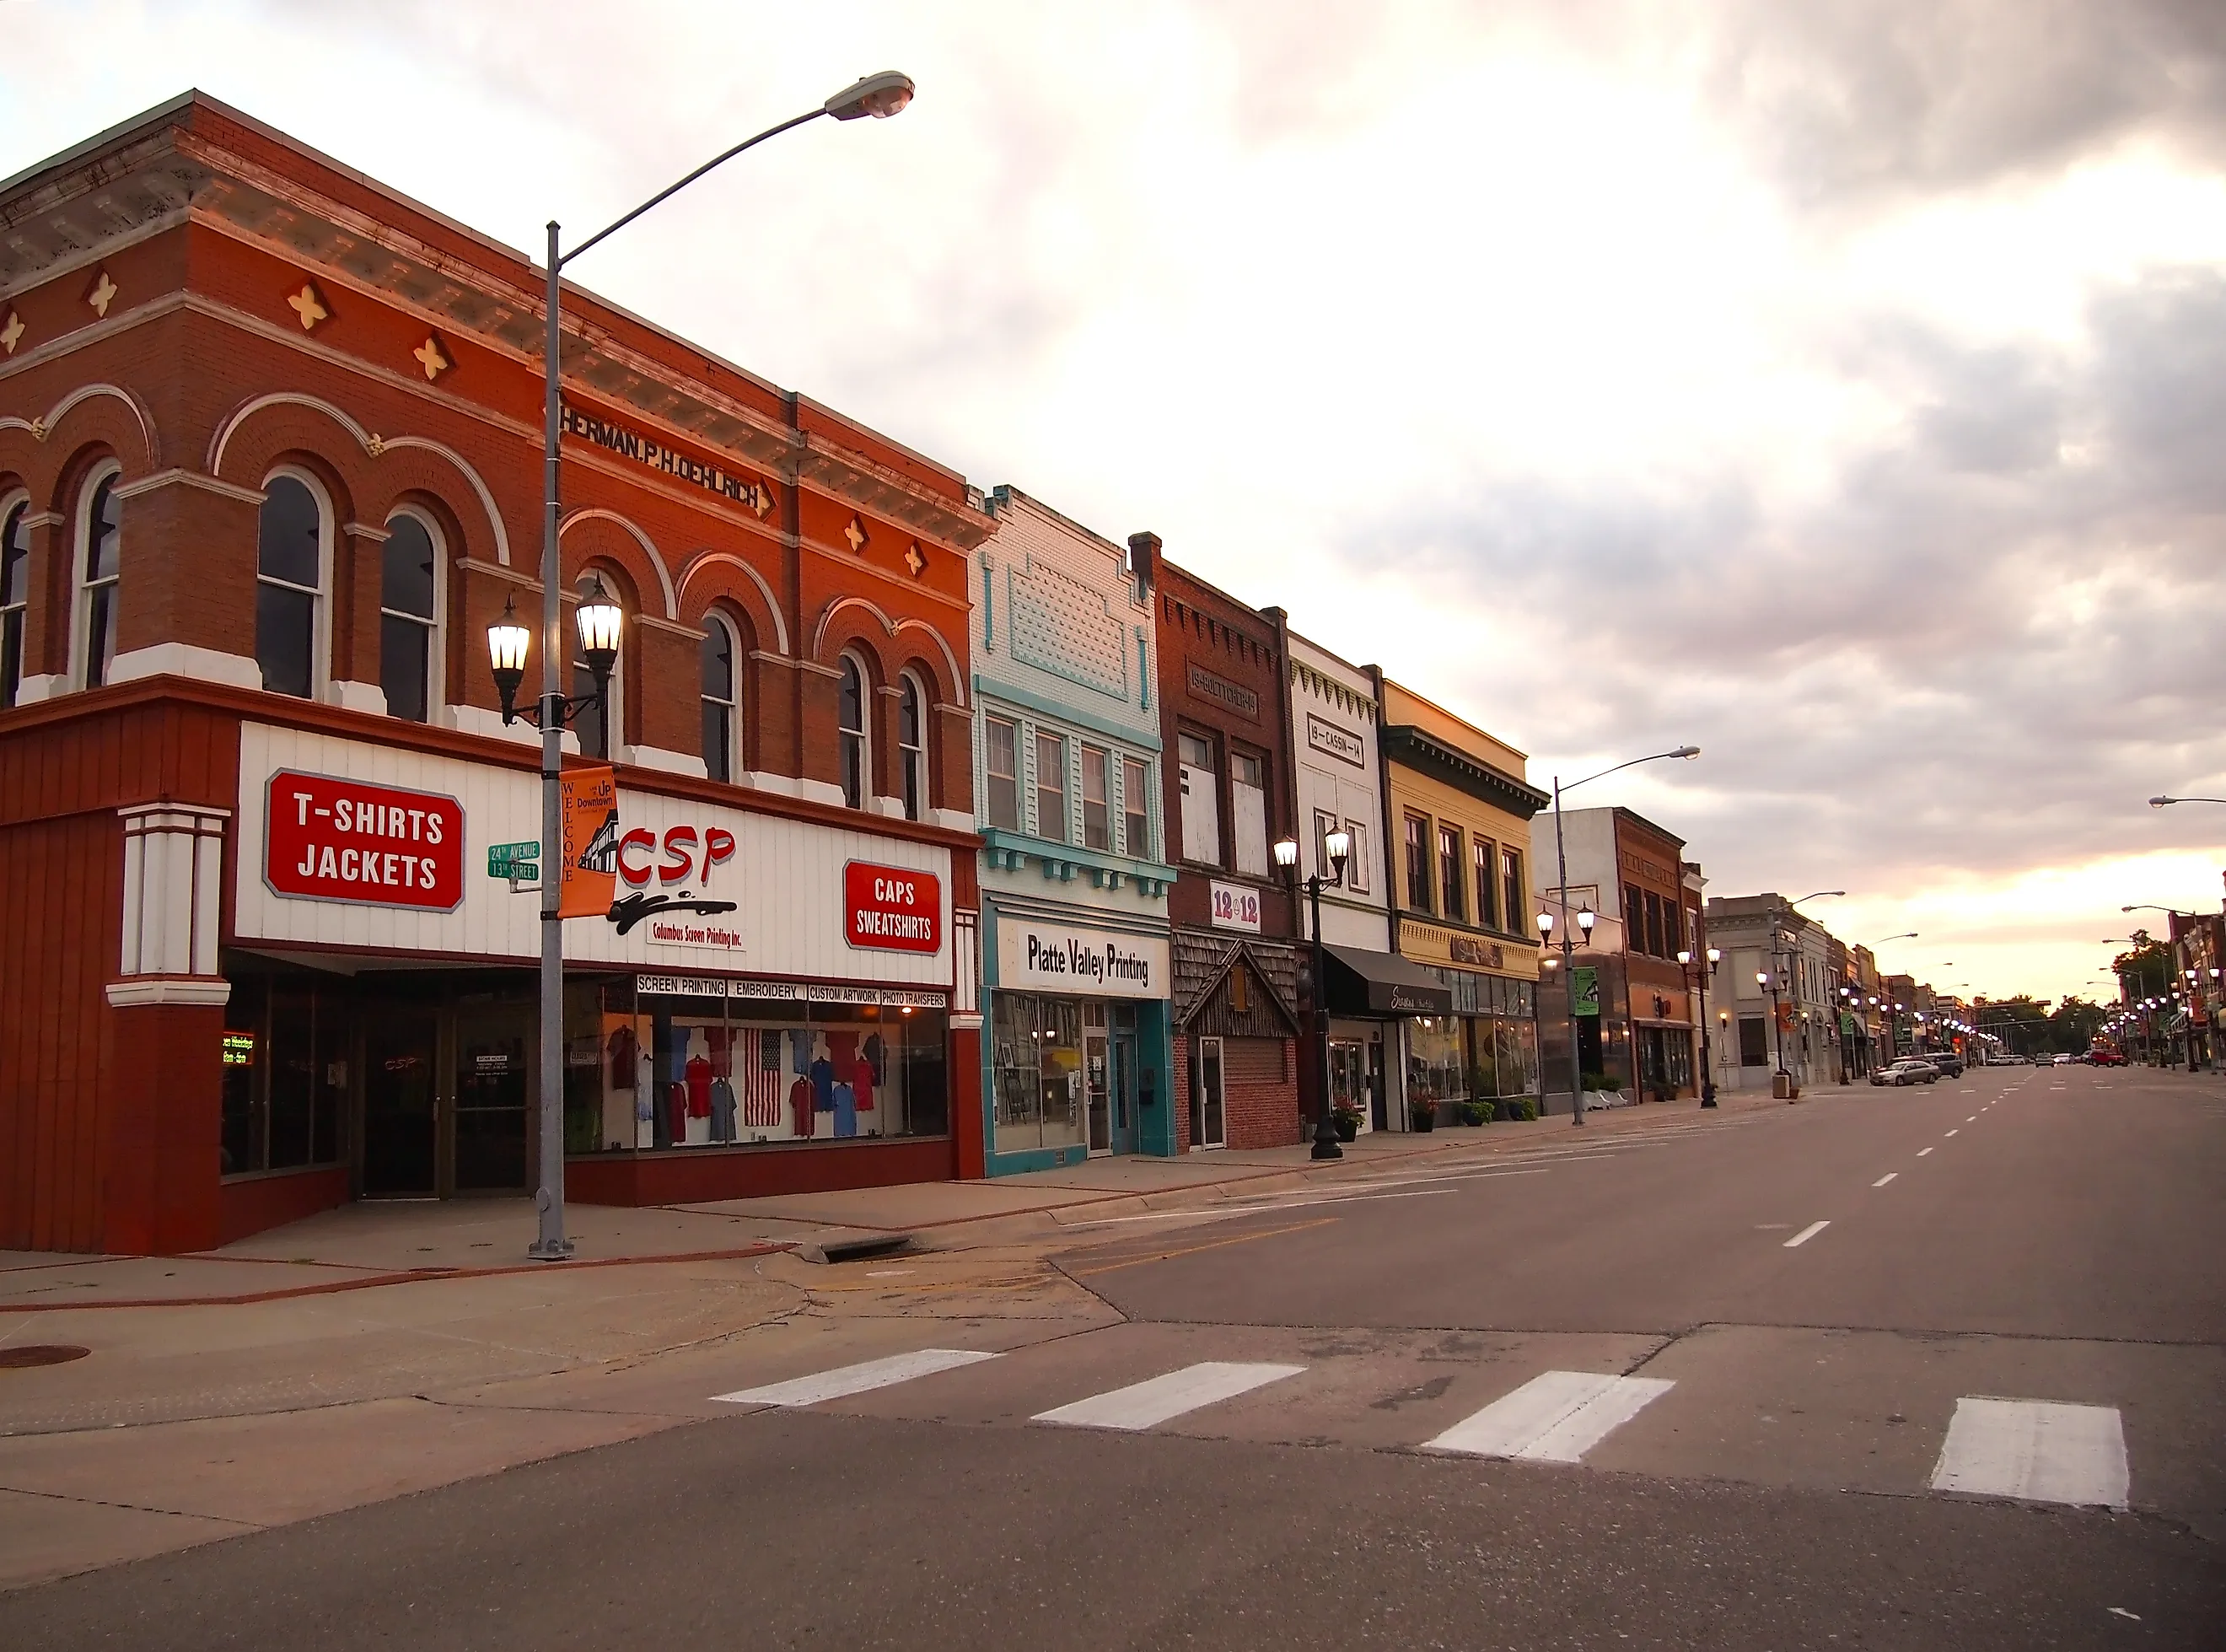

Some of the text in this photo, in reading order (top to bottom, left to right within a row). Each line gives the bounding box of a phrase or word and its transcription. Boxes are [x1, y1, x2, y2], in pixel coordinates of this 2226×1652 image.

[598, 779, 611, 796] UP
[577, 797, 613, 808] Downtown
[293, 793, 444, 844] T-SHIRTS
[562, 782, 574, 882] WELCOME
[509, 843, 537, 858] AVENUE
[617, 826, 736, 889] CSP
[298, 844, 436, 890] JACKETS
[510, 864, 536, 879] STREET
[874, 878, 914, 906] CAPS
[1214, 890, 1258, 924] 12 12
[653, 922, 742, 950] Columbus Screen Printing Inc.
[857, 909, 931, 940] SWEATSHIRTS
[1028, 934, 1148, 988] Platte Valley Printing
[638, 976, 724, 995] SCREEN PRINTING
[736, 982, 797, 1000] EMBROIDERY
[809, 987, 877, 1004] CUSTOM ARTWORK
[882, 993, 944, 1006] PHOTO TRANSFERS
